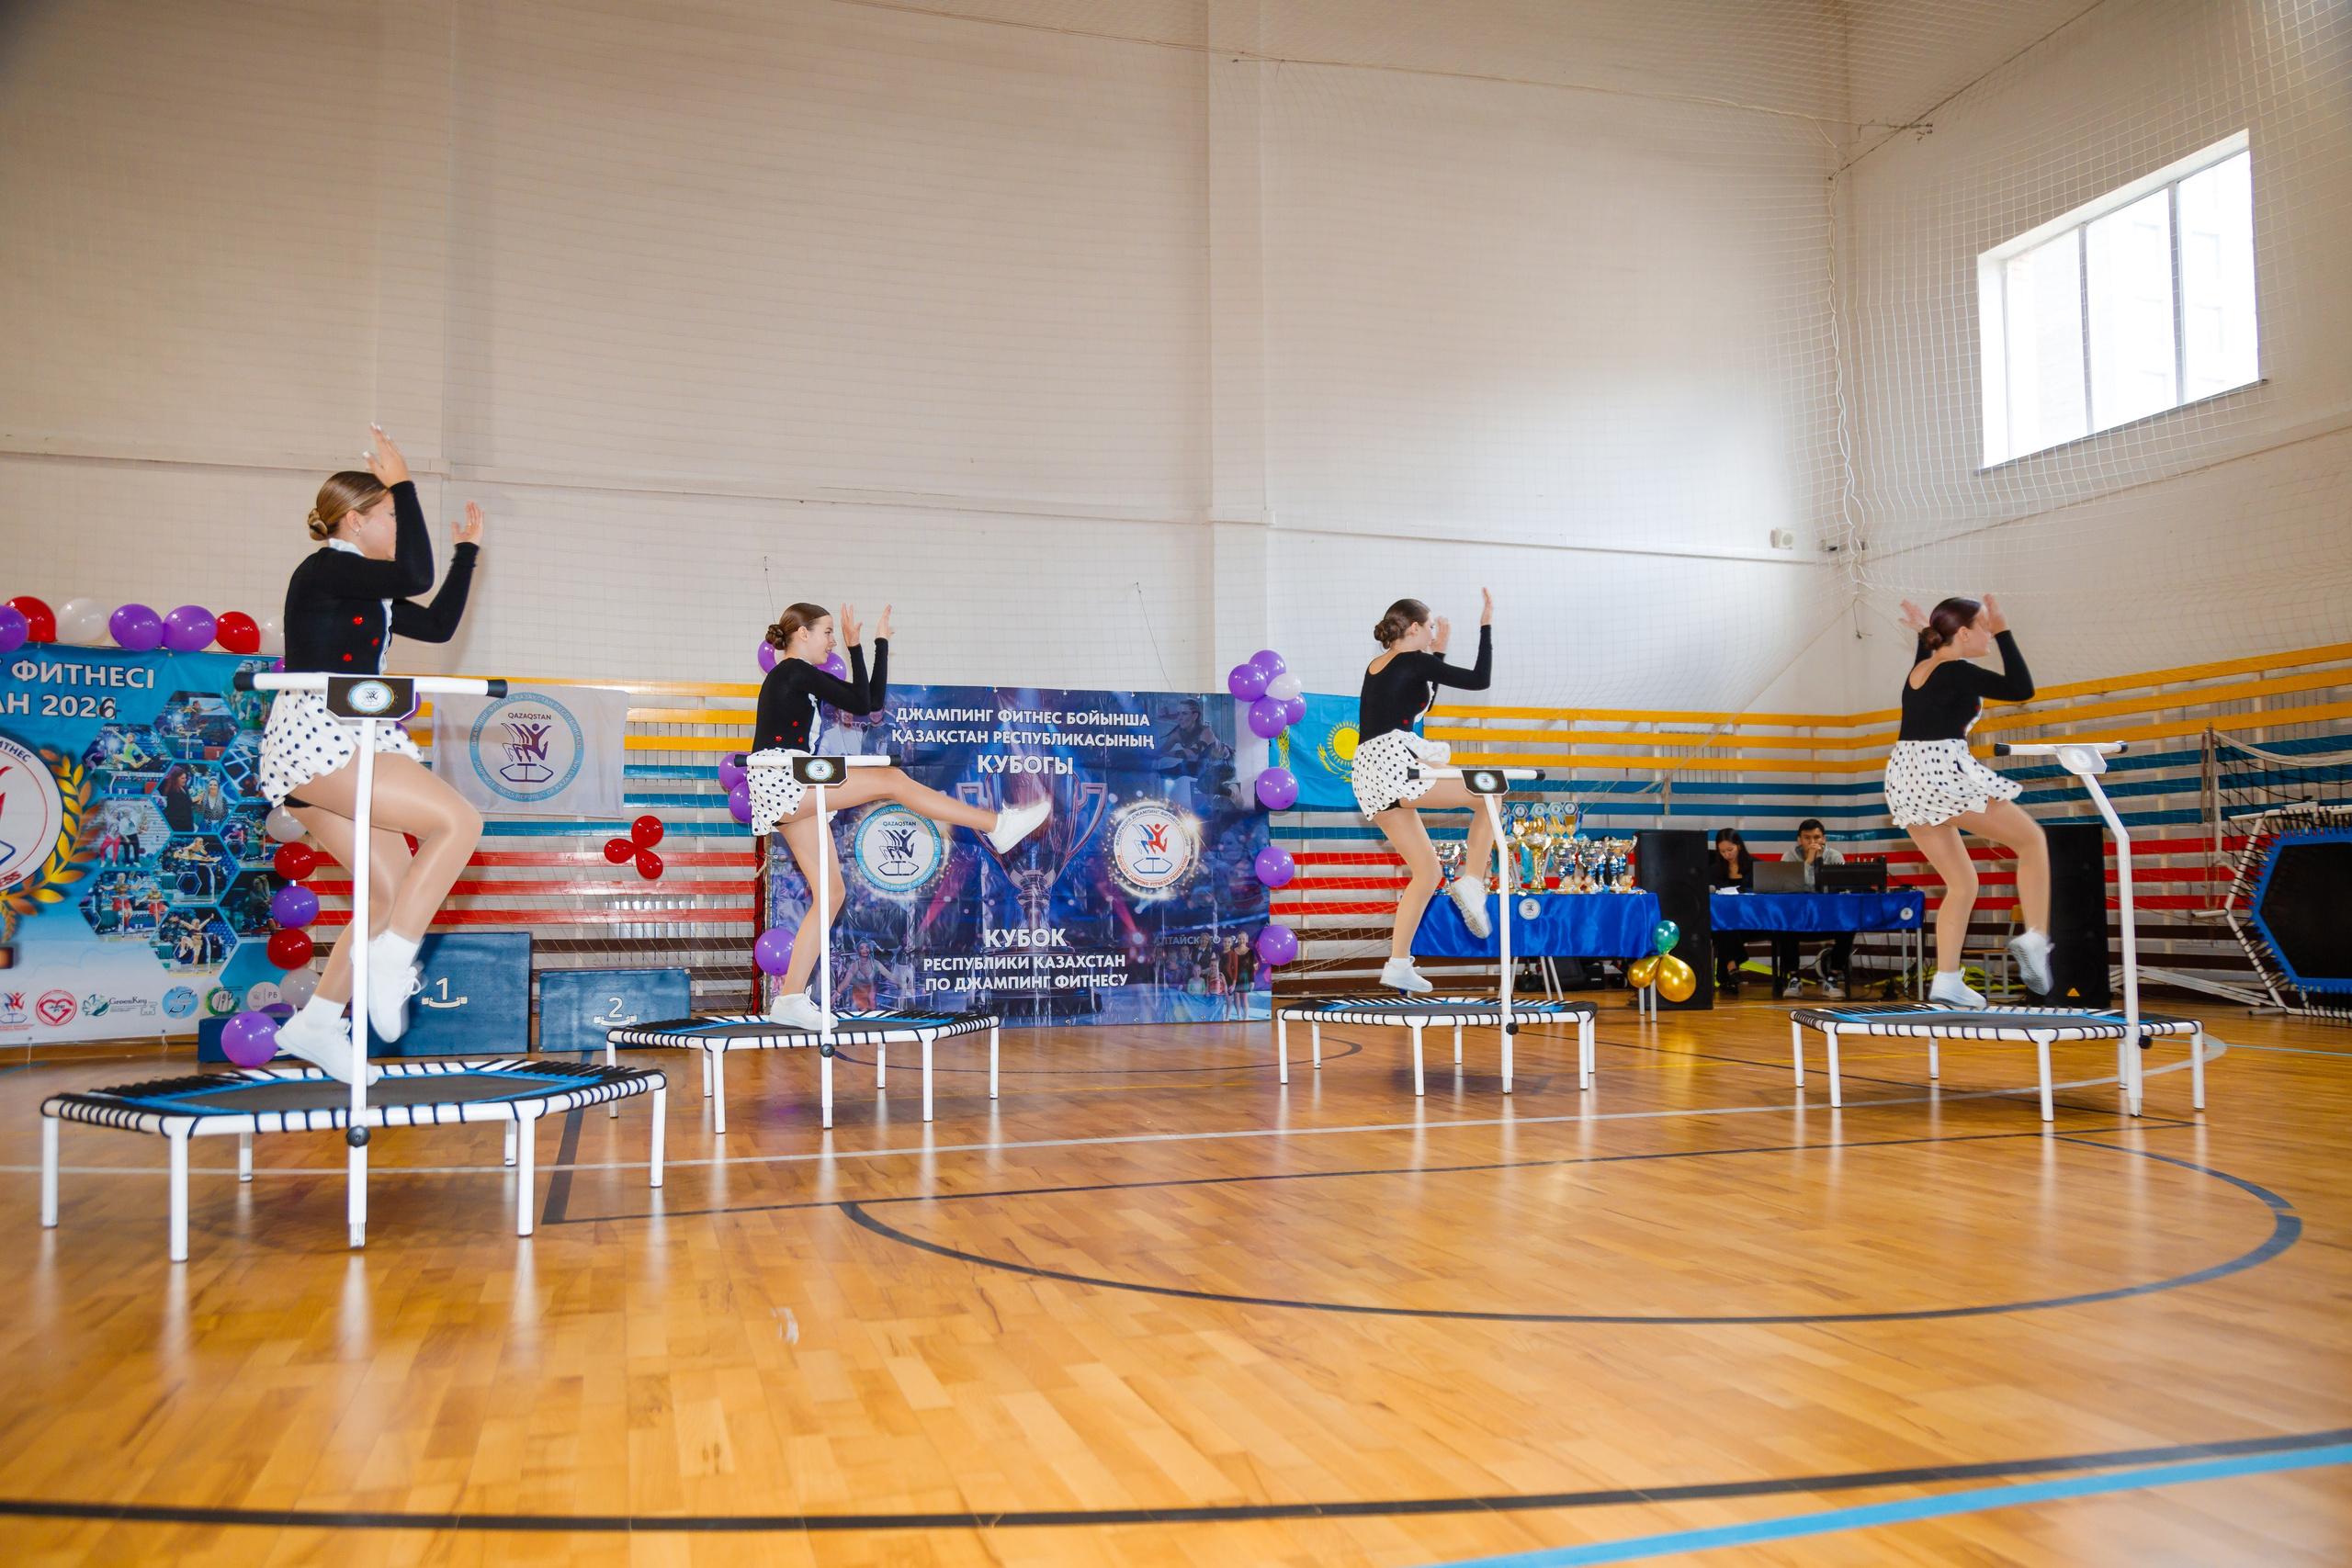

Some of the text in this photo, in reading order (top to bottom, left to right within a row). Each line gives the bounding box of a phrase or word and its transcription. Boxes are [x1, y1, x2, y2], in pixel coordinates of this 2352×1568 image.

[11, 660, 154, 689] ФИТНЕСІ
[41, 694, 117, 719] 2026
[507, 712, 552, 720] QAZAQSTAN
[896, 707, 1150, 727] ДЖАМПИНГ ФИТНЕС БОЙЫНША
[891, 728, 1155, 750] ҚАЗАҚСТАН РЕСПУБЛИКАСЫНЫҢ
[978, 754, 1073, 775] КУБОГЫ
[474, 760, 492, 784] JUMPING
[492, 782, 514, 798] FITNESS
[515, 792, 547, 800] REPUBLIC
[1131, 809, 1159, 819] ДЖАМПИНГ
[1129, 874, 1148, 886] JUMPING
[1170, 854, 1189, 880] FEDERATION
[985, 928, 1068, 947] КУБОК
[923, 954, 1125, 971] РЕСПУБЛИКИ КАЗАХСТАН
[436, 977, 448, 1001] 1
[925, 974, 1128, 993] ПО ДЖАМПИНГ ФИТНЕСУ
[608, 997, 623, 1019] 2
